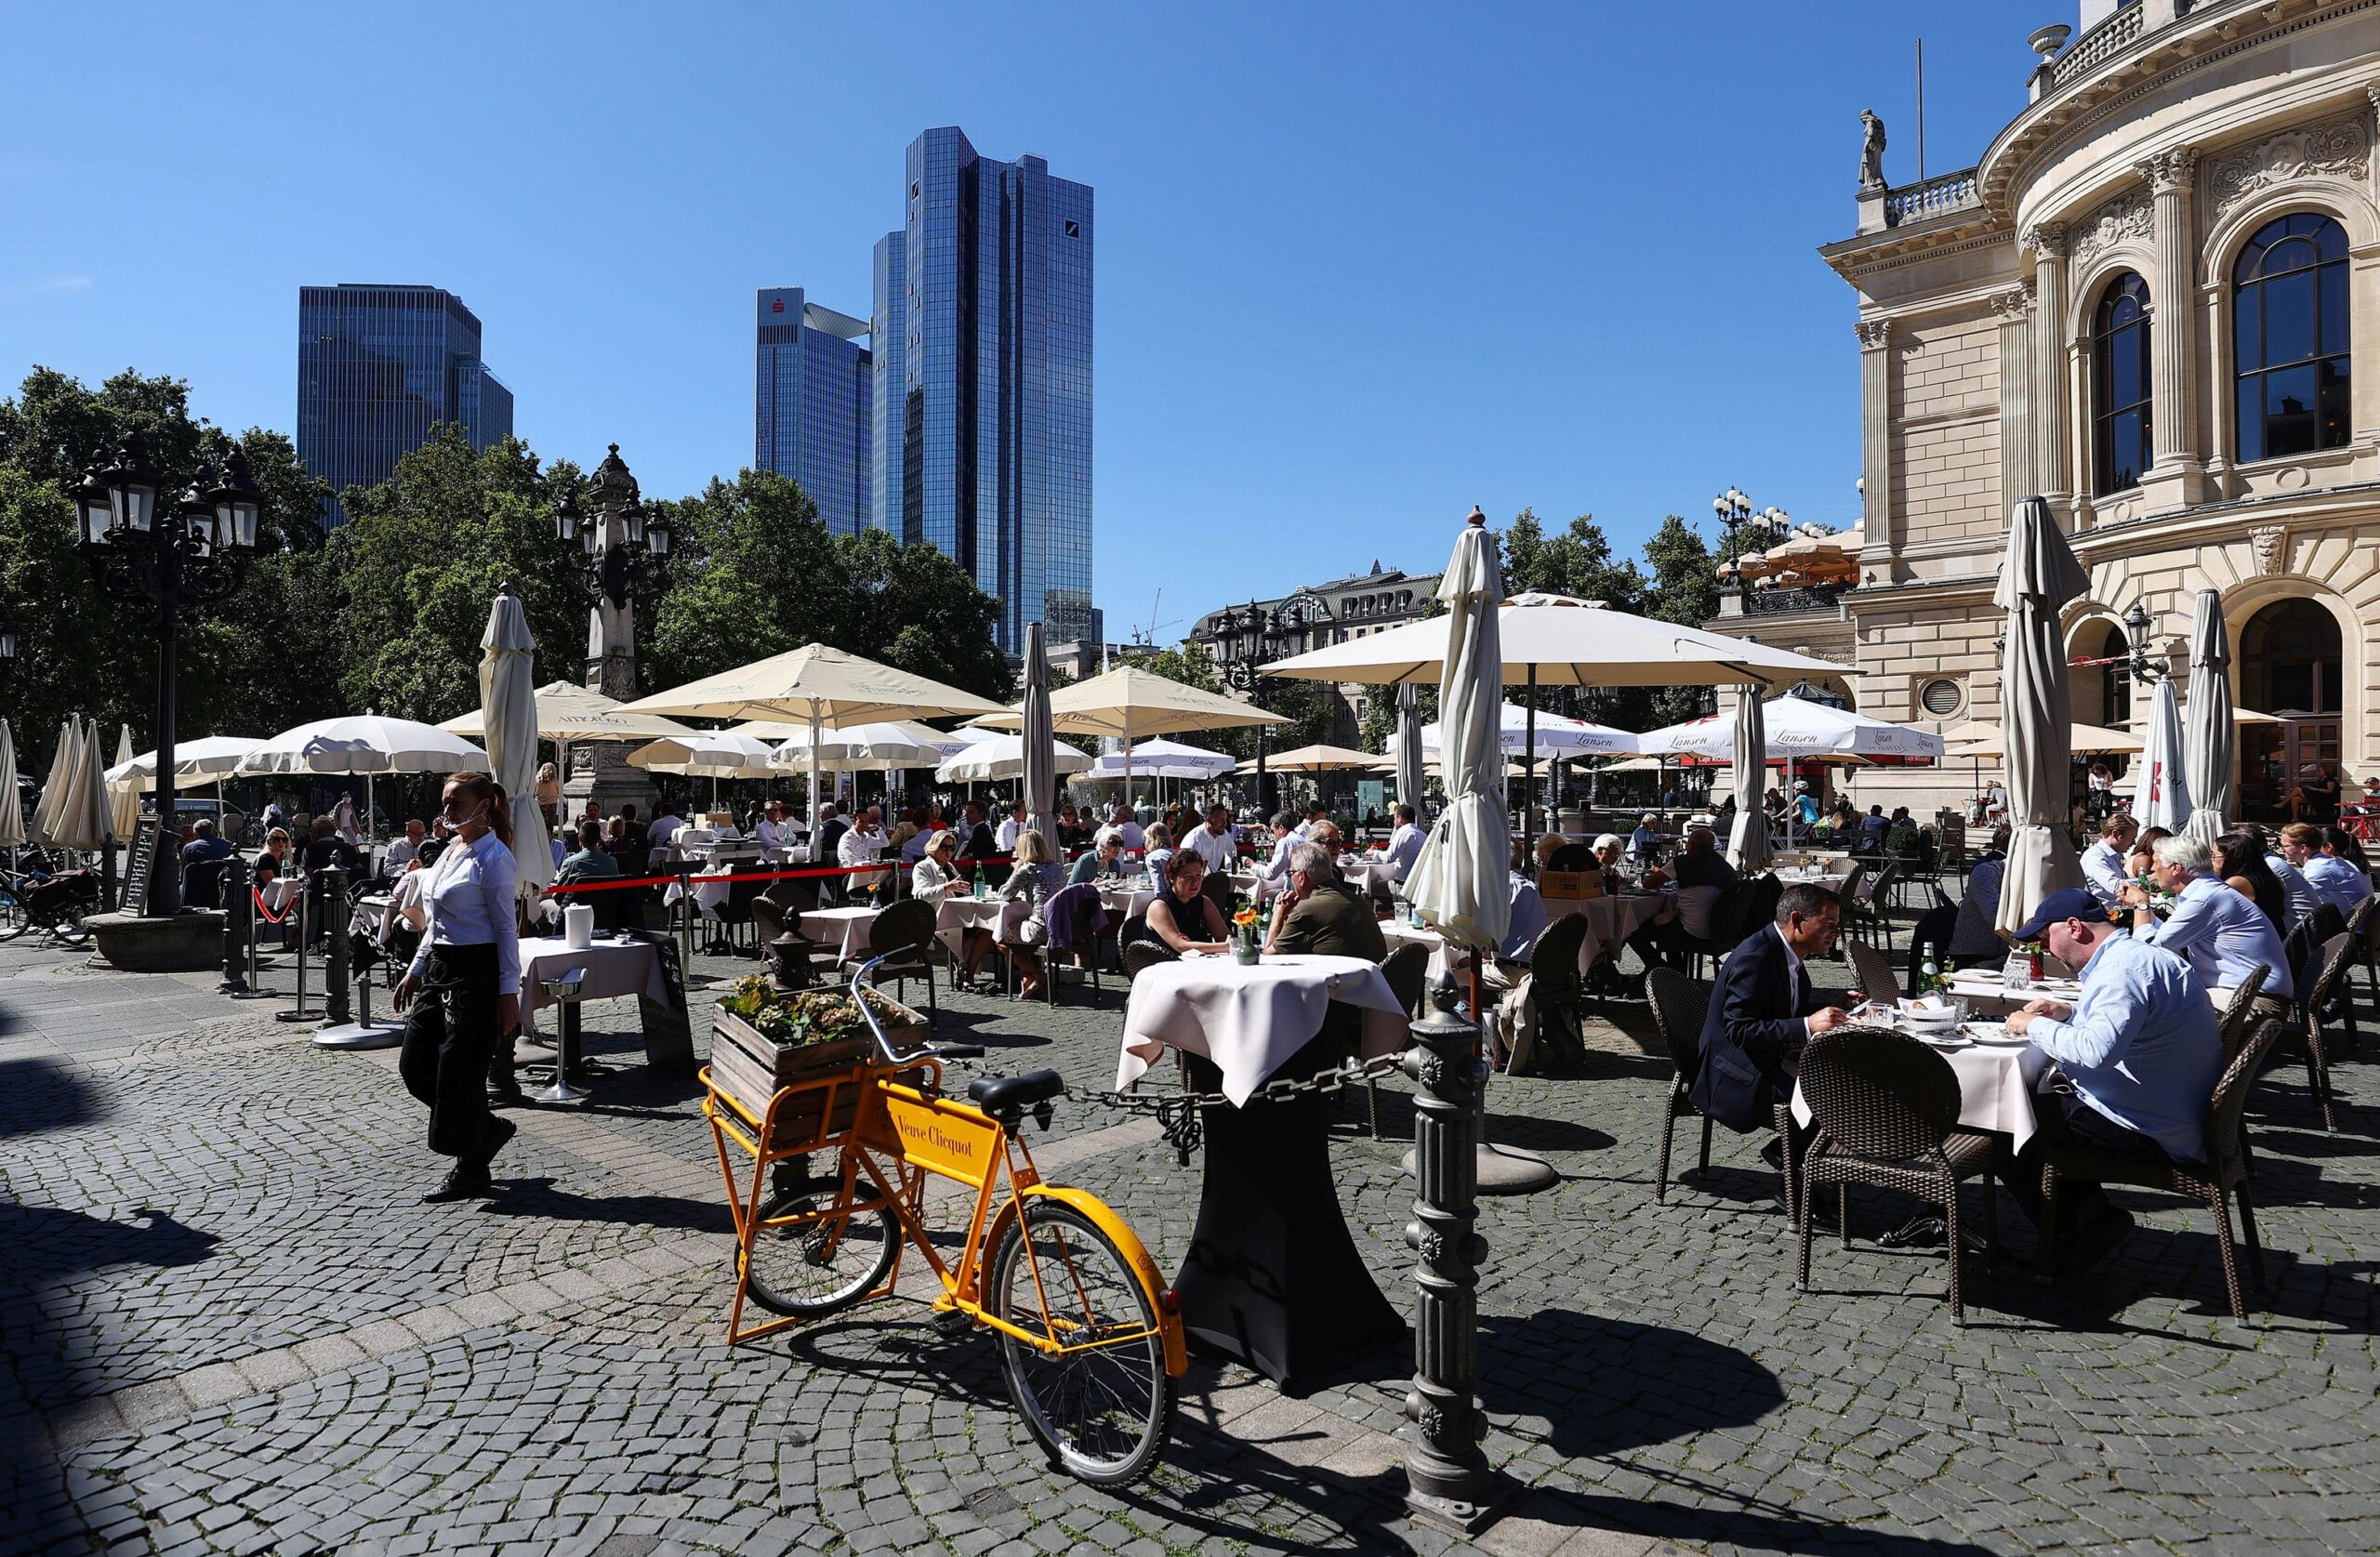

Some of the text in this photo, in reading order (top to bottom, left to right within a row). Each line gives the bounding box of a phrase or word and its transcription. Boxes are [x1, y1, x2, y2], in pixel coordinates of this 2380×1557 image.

[1576, 732, 1615, 746] Lanson
[1669, 734, 1708, 749] Lanson
[1775, 729, 1818, 746] Lanson
[1189, 757, 1216, 766] Lanson
[898, 1115, 973, 1158] Veuve Clicquot
